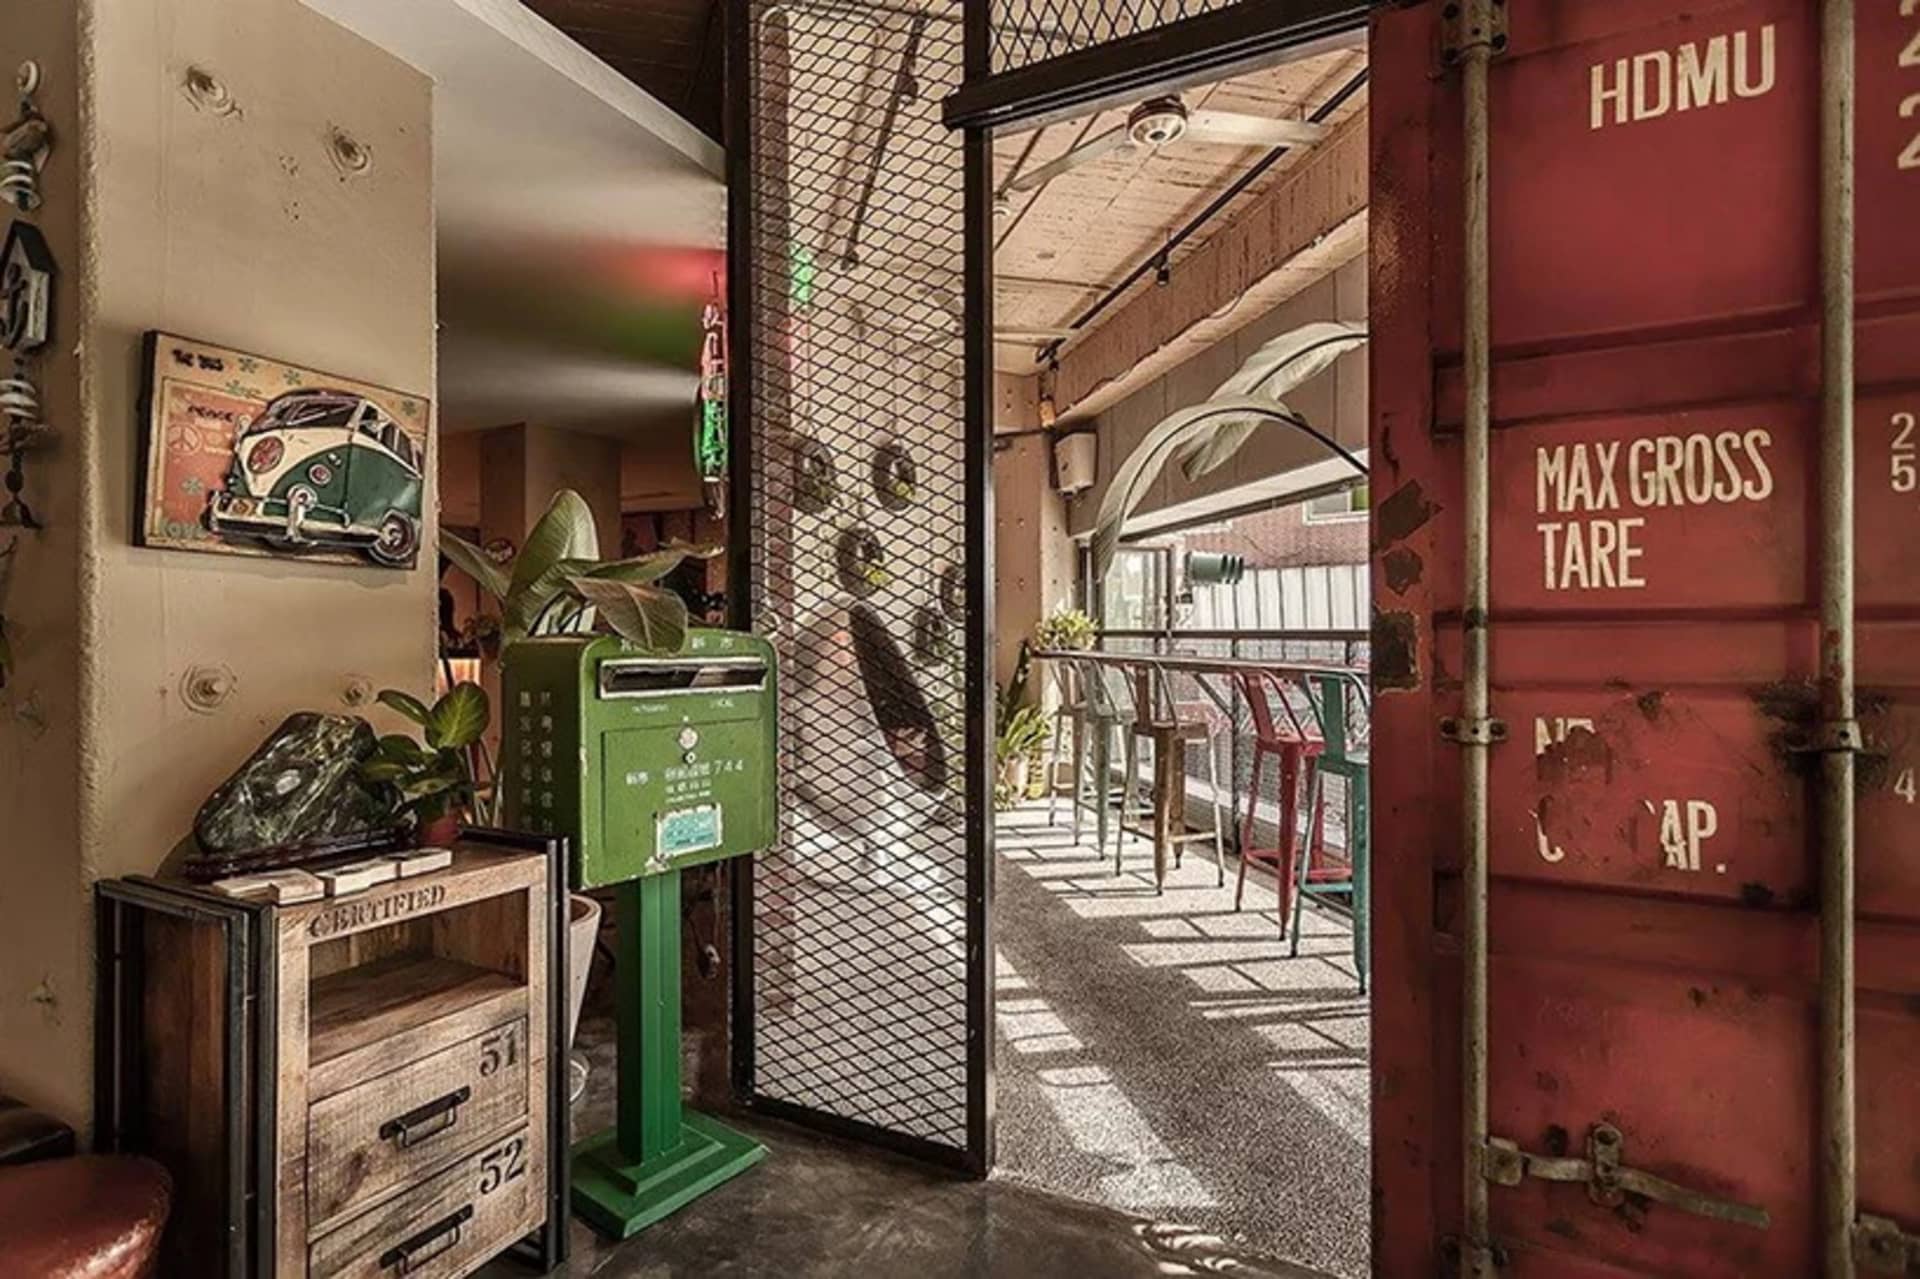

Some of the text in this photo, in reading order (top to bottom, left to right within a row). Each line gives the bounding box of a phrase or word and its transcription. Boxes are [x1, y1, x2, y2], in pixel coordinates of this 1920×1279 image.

[1590, 25, 1777, 130] HDMU
[1891, 411, 1916, 450] 2
[1536, 429, 1774, 514] MAX GROSS
[1891, 453, 1917, 493] 5
[1537, 517, 1646, 591] TARE
[1645, 799, 1727, 874] AP.
[305, 884, 446, 938] CERTIFIED
[479, 1030, 520, 1079] 51
[479, 1137, 525, 1195] 52
